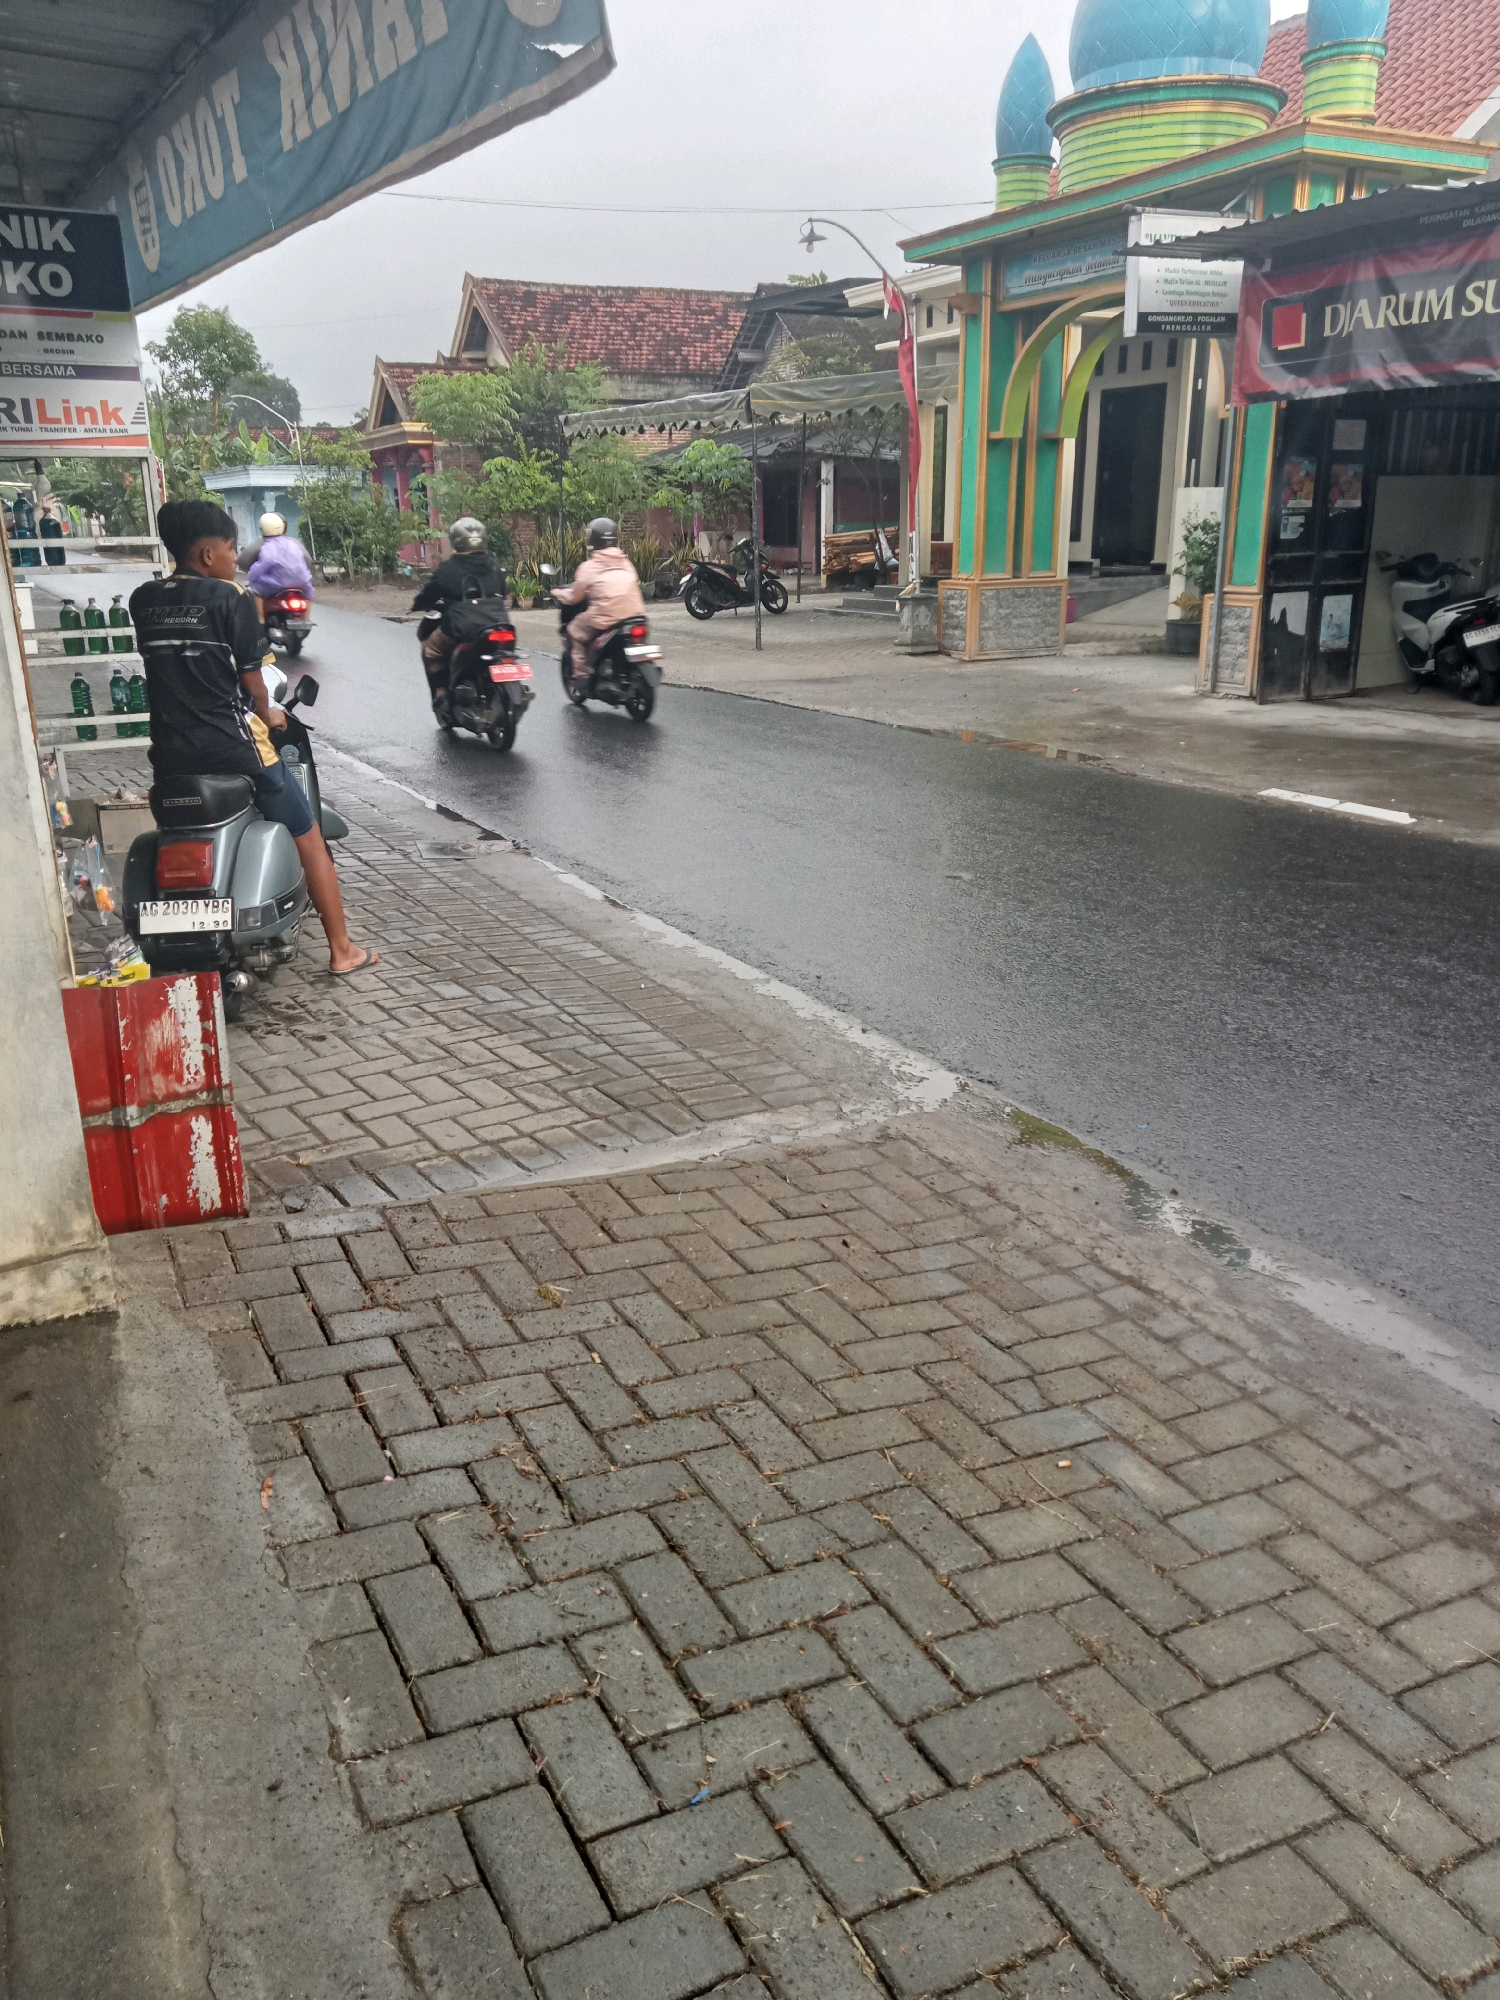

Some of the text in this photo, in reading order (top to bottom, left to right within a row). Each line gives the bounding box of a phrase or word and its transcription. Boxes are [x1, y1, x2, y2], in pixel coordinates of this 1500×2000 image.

[1419, 208, 1470, 225] PERINGATAN
[1033, 248, 1071, 264] KELUARGA
[1073, 241, 1098, 255] BESAR
[0, 261, 73, 298] KO
[1197, 315, 1226, 323] POGALAN
[1323, 285, 1456, 338] DJARUM
[37, 331, 104, 344] SEMBAKO
[2, 363, 76, 377] BERSAMA
[140, 899, 231, 917] AG 2030 YBG
